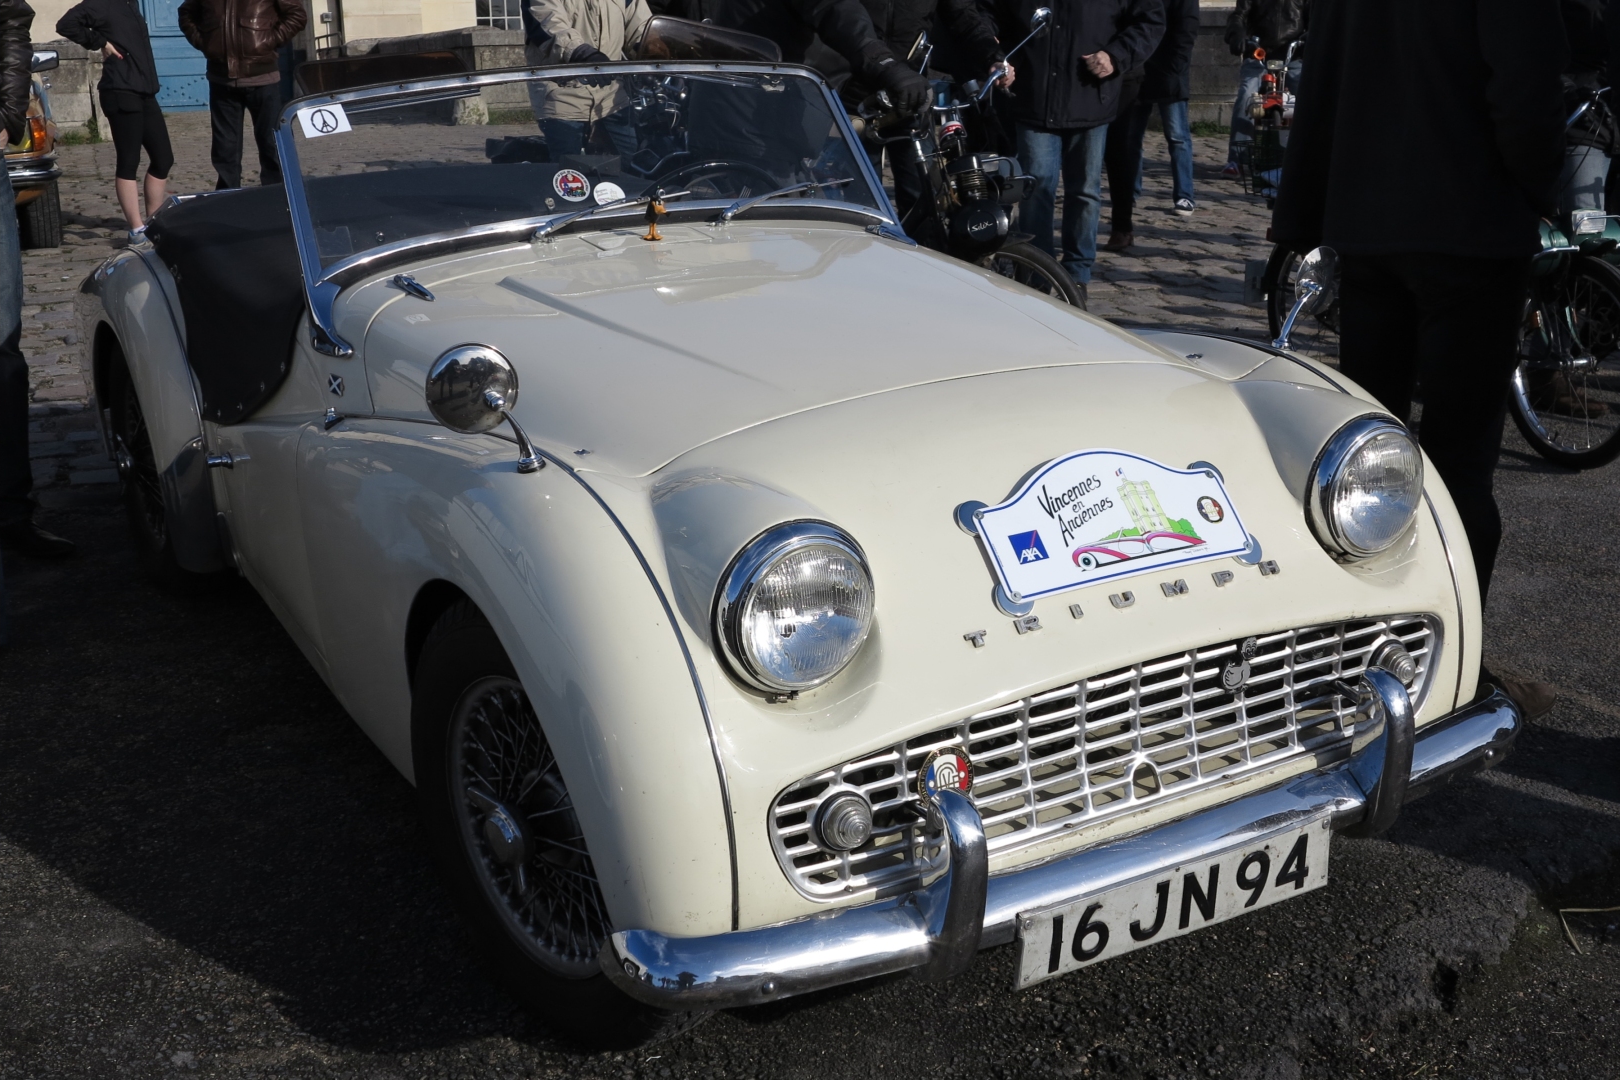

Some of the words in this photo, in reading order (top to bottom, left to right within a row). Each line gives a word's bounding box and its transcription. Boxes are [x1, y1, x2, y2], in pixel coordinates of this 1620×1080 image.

[1037, 474, 1101, 519] Vincennes
[1072, 500, 1086, 514] en
[1058, 496, 1114, 548] Anciennes
[1019, 546, 1044, 564] AXA
[963, 559, 1280, 648] TRIUMPH
[1047, 902, 1110, 974] 16
[1129, 863, 1220, 942] JN
[1236, 833, 1309, 909] 94
